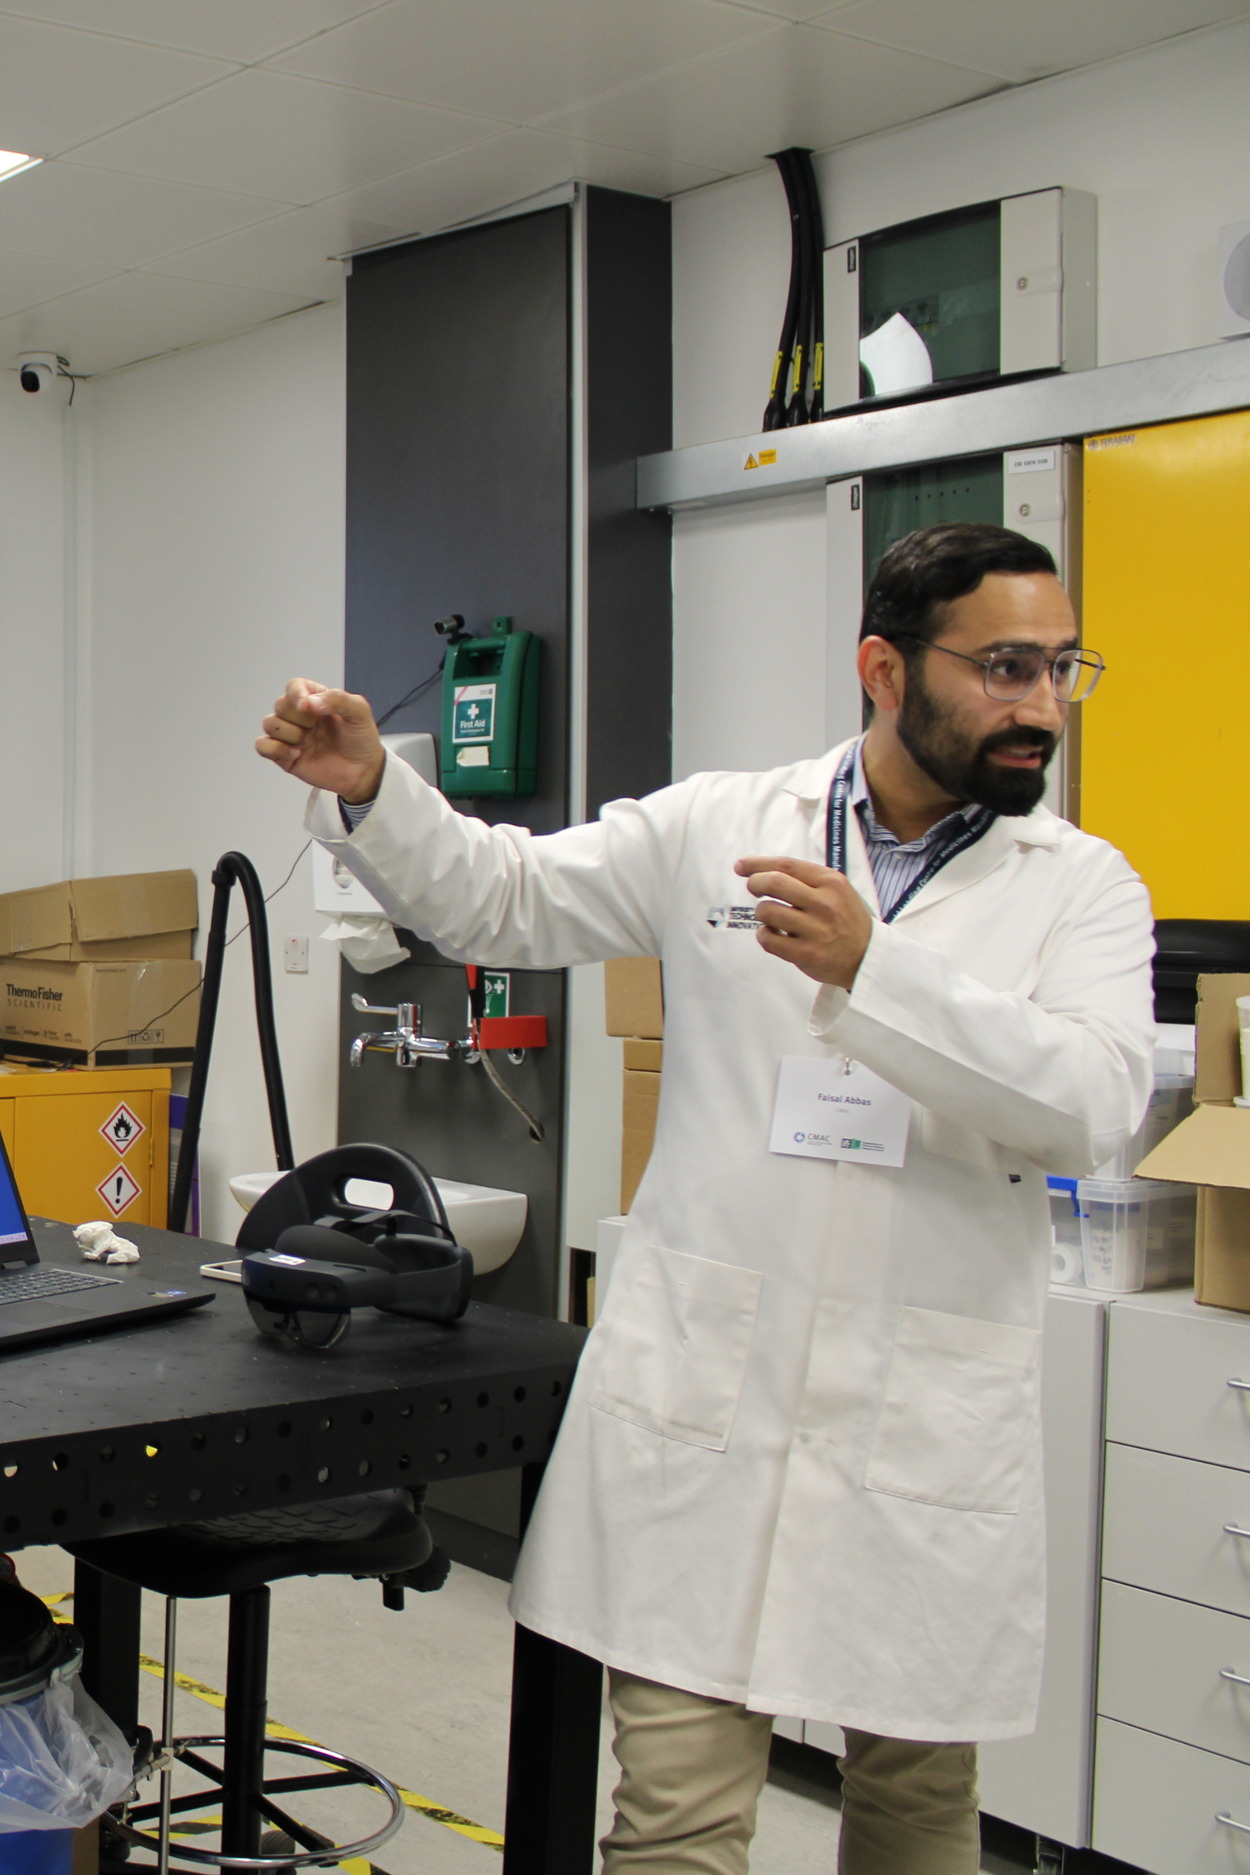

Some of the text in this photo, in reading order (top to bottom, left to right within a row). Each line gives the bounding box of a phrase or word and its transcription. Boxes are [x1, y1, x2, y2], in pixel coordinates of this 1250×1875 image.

[1100, 434, 1136, 446] TERASAKI
[461, 719, 486, 728] First Aid
[833, 798, 842, 808] for
[833, 809, 842, 845] Medicines
[918, 866, 934, 887] Centre
[940, 832, 972, 860] Medicines
[6, 983, 63, 1002] ThermoFisher
[8, 998, 62, 1012] SCIENTIFIC
[818, 1093, 872, 1106] Faisal Abbas
[808, 1133, 831, 1142] CMAC
